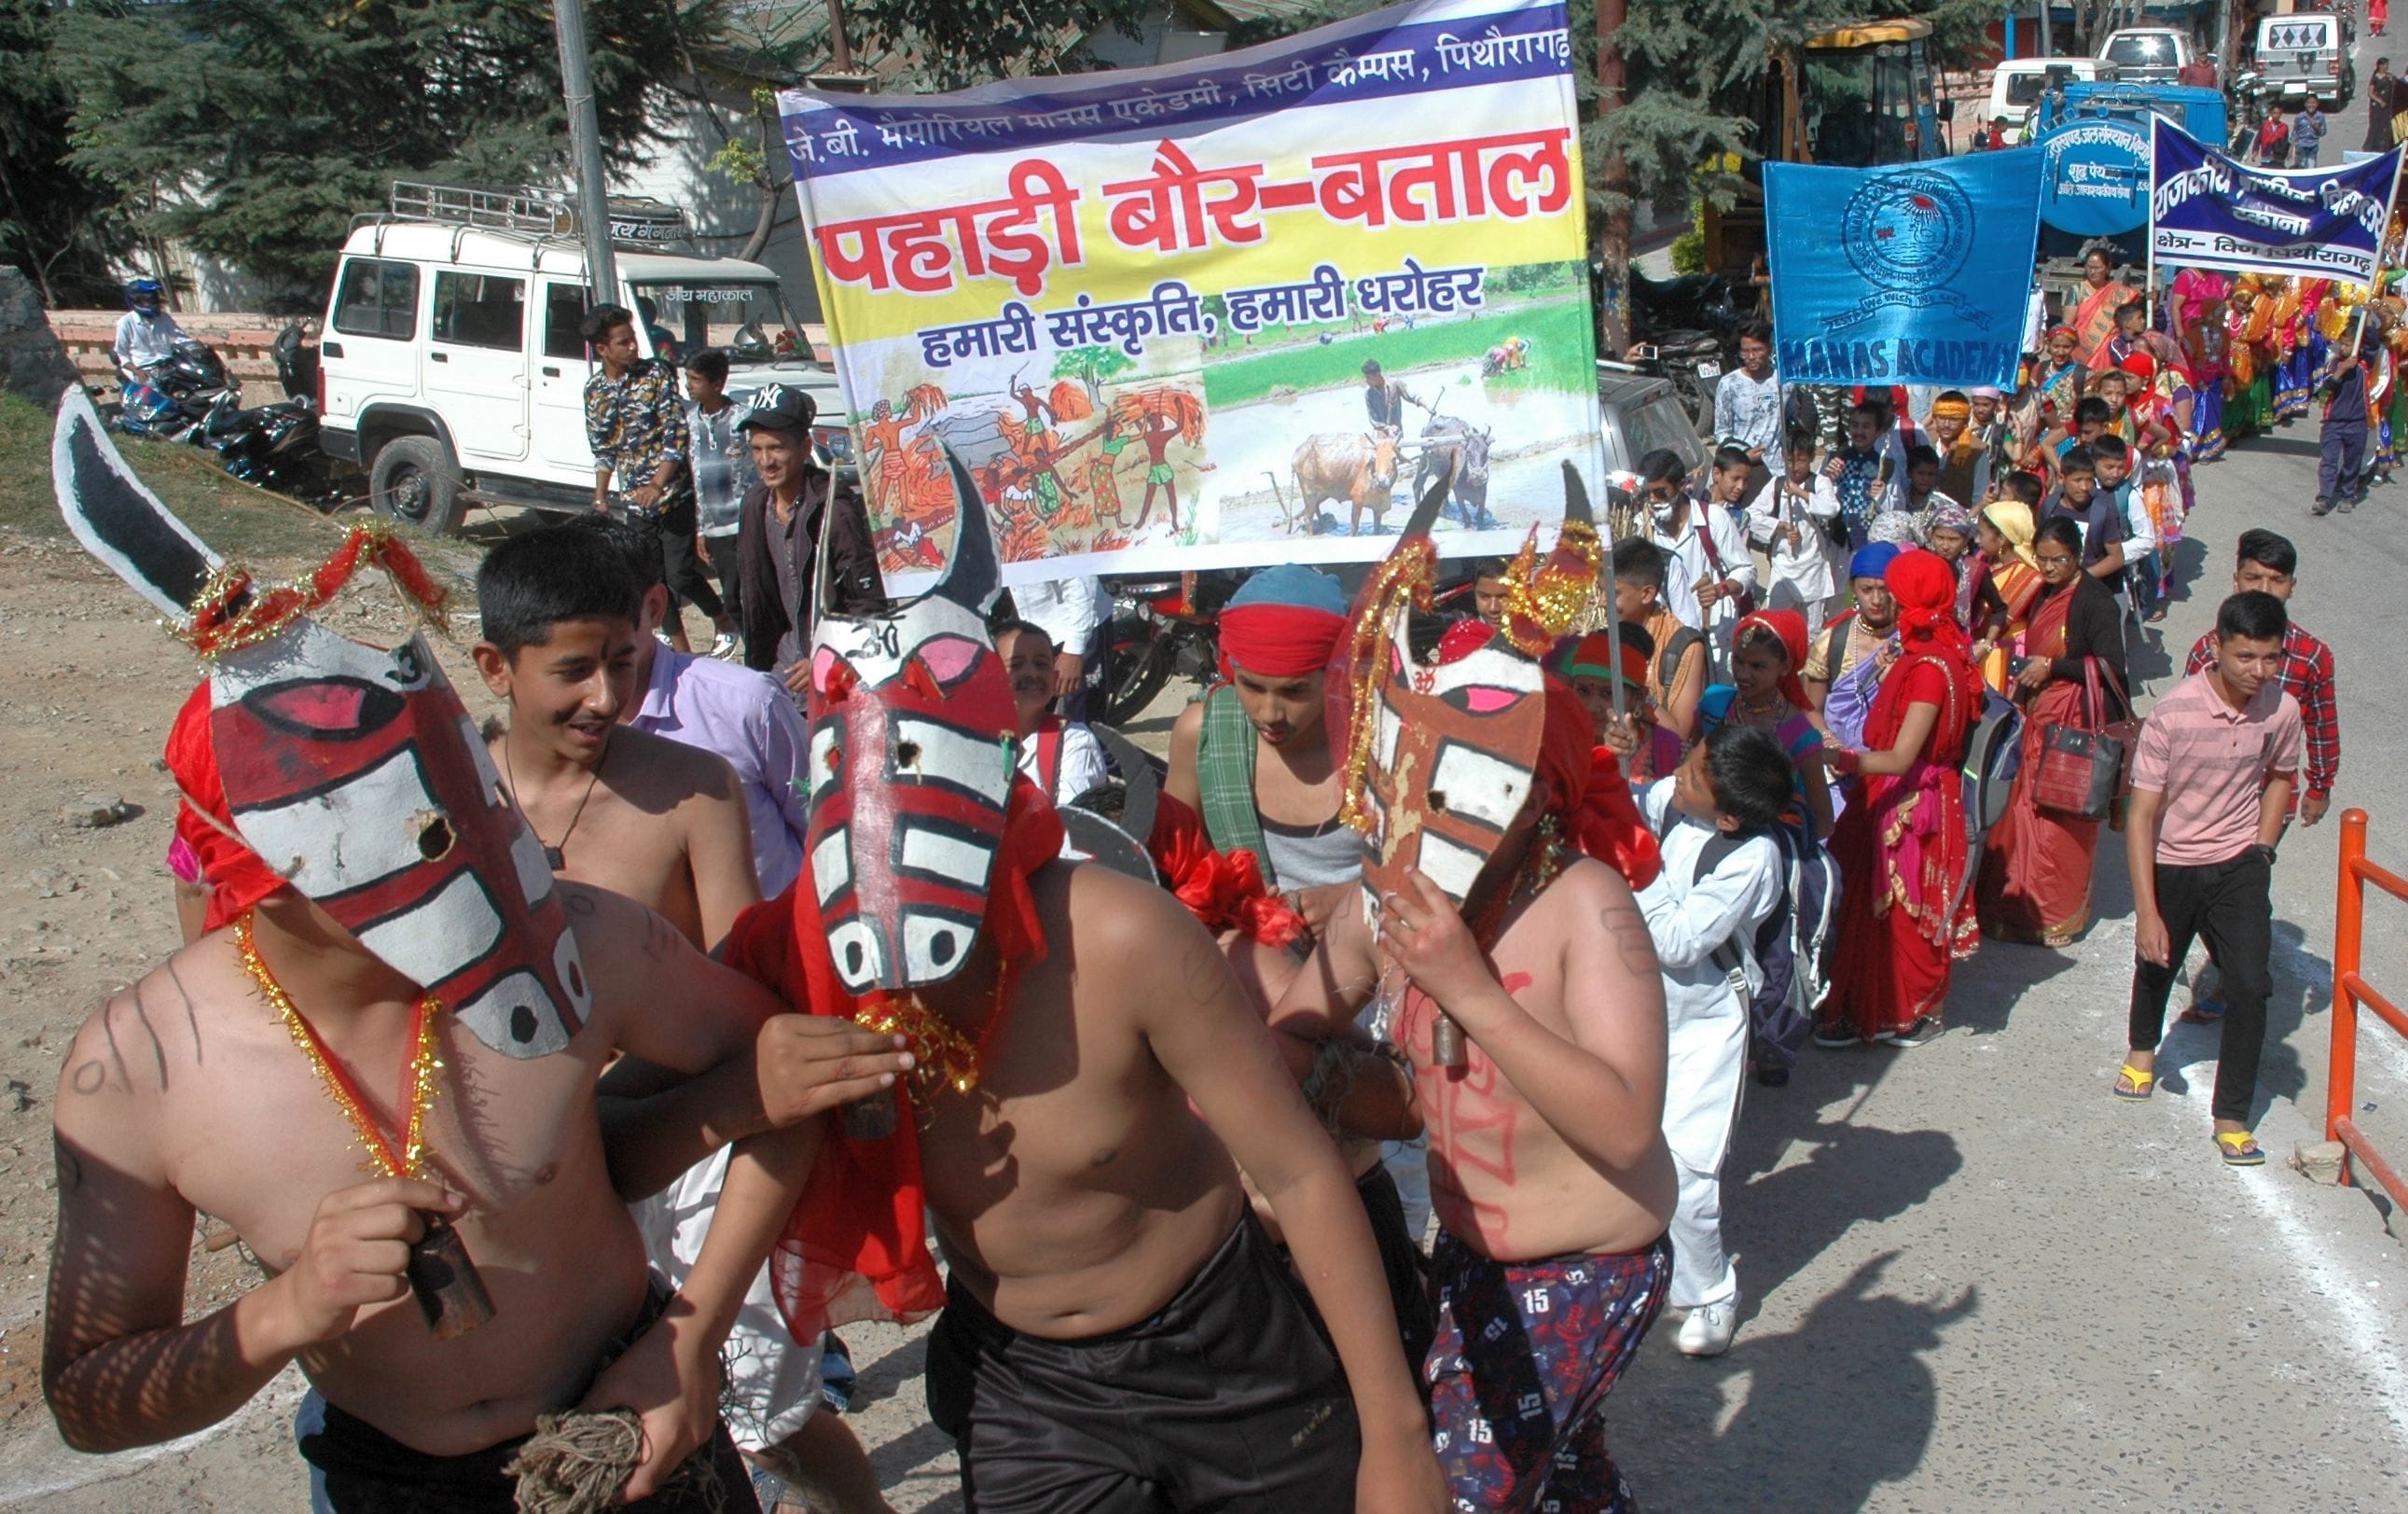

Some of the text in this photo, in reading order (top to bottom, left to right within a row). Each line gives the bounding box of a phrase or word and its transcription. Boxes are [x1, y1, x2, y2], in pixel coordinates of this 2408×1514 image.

[1021, 103, 1102, 130] मानस
[1241, 62, 1313, 99] सिटी
[812, 159, 1082, 296] पहाड़ी
[695, 289, 754, 304] महाकाल
[918, 257, 1484, 368] हमारी संस्कृति, हमारी धरोहर
[1780, 337, 2020, 383] MANAS ACADEMY
[1522, 1288, 1549, 1314] 15
[1517, 1393, 1543, 1421] 15
[1468, 1418, 1493, 1444] 15
